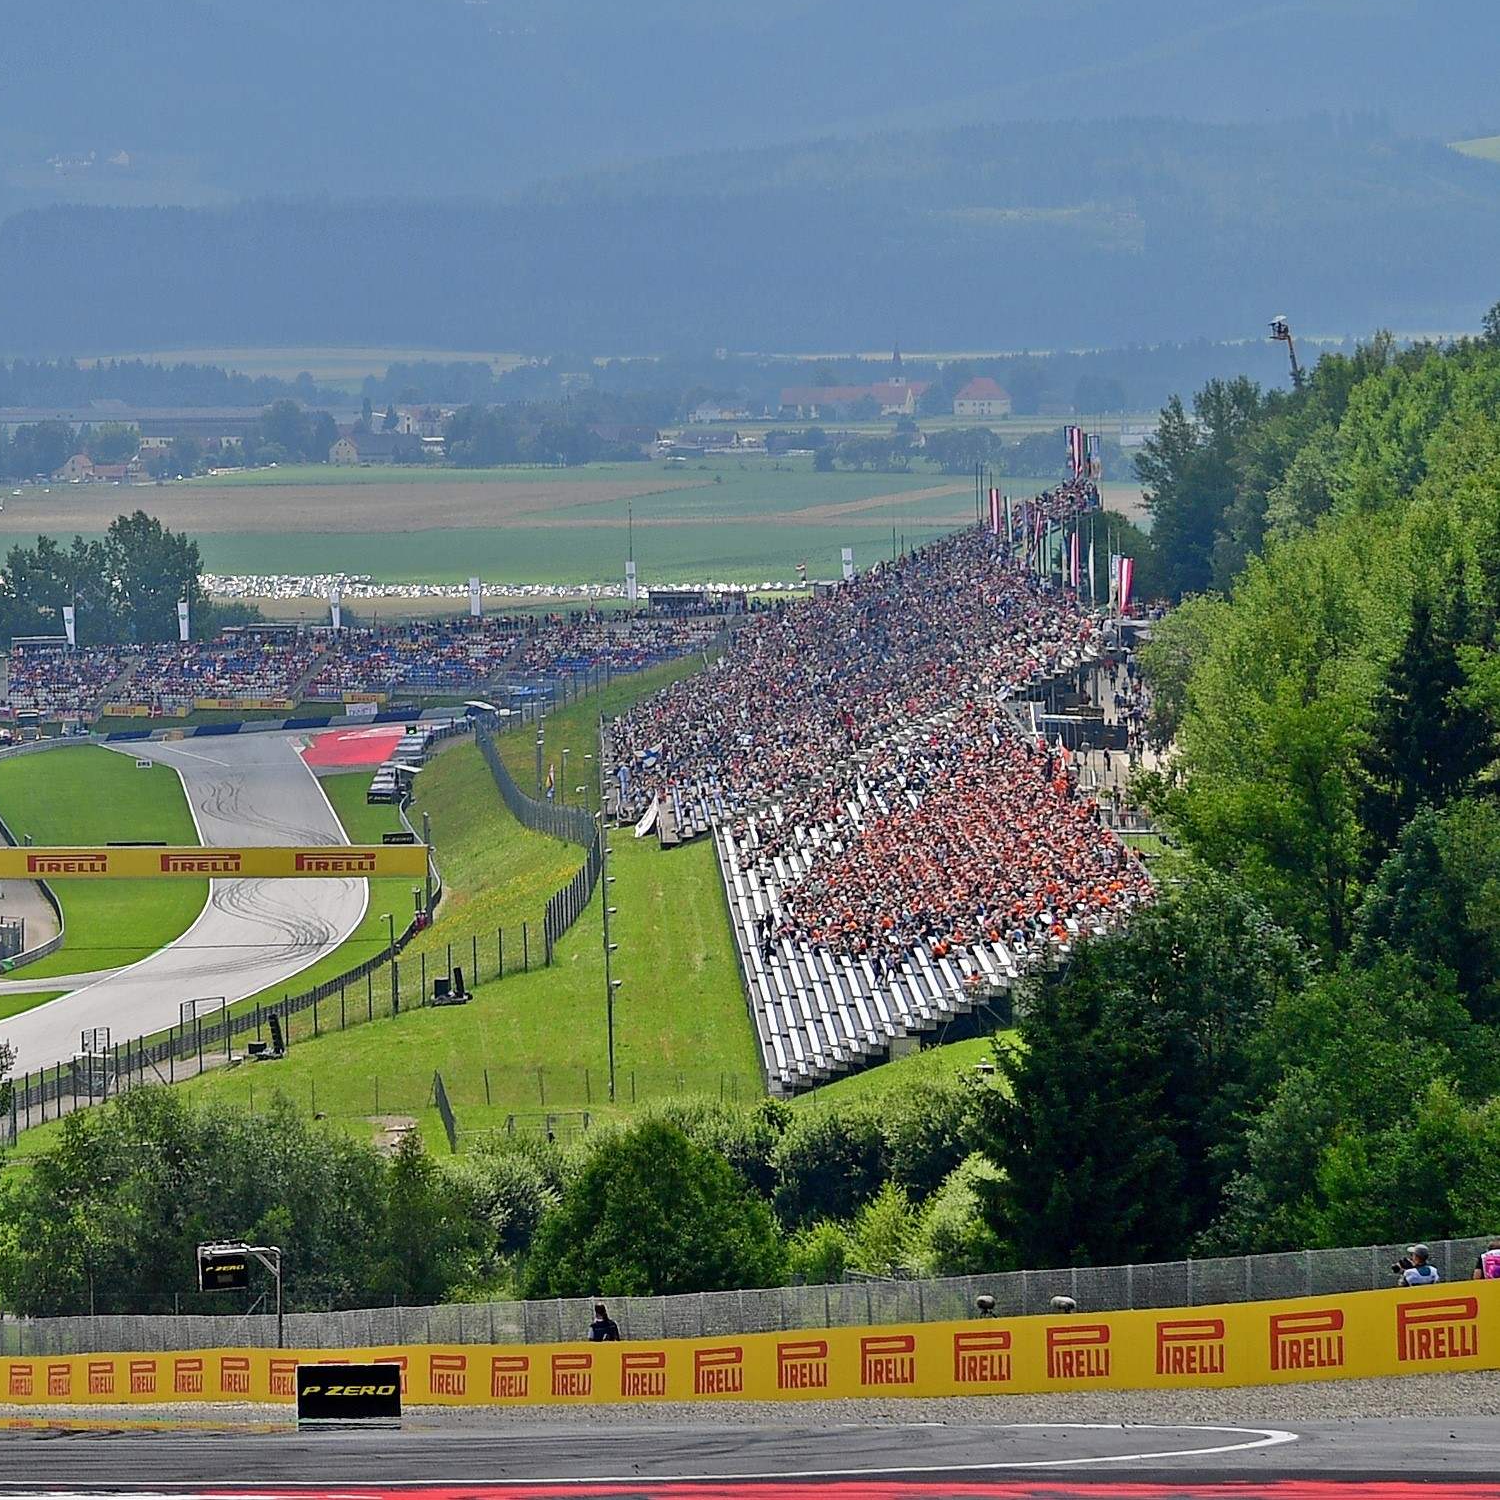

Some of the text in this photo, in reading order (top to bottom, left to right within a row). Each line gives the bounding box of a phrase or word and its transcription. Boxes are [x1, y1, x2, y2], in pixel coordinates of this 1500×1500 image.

[27, 854, 107, 873] PIRELLI
[160, 853, 240, 872] PIRELLI
[295, 853, 376, 871] PIRELLI
[1156, 1319, 1225, 1375] PIRELLI
[1269, 1309, 1344, 1371] PIRELLI
[1397, 1297, 1478, 1361] PIRELLI
[694, 1346, 743, 1394] PIRELLI
[777, 1341, 828, 1389] PIRELLI
[861, 1335, 915, 1385] PIRELLI
[954, 1331, 1012, 1382] PIRELLI
[1046, 1325, 1110, 1378] PIRELLI
[9, 1365, 33, 1396] PIRELLI
[48, 1364, 70, 1396] PIRELLI
[89, 1362, 114, 1395] PIRELLI
[130, 1360, 156, 1395] PIRELLI
[175, 1359, 203, 1393] PIRELLI
[221, 1357, 250, 1393] PIRELLI
[302, 1385, 396, 1396] P ZERO
[430, 1354, 466, 1396] PIRELLI
[492, 1356, 529, 1398] PIRELLI
[552, 1353, 592, 1396] PIRELLI
[621, 1352, 666, 1397] PIRELLI
